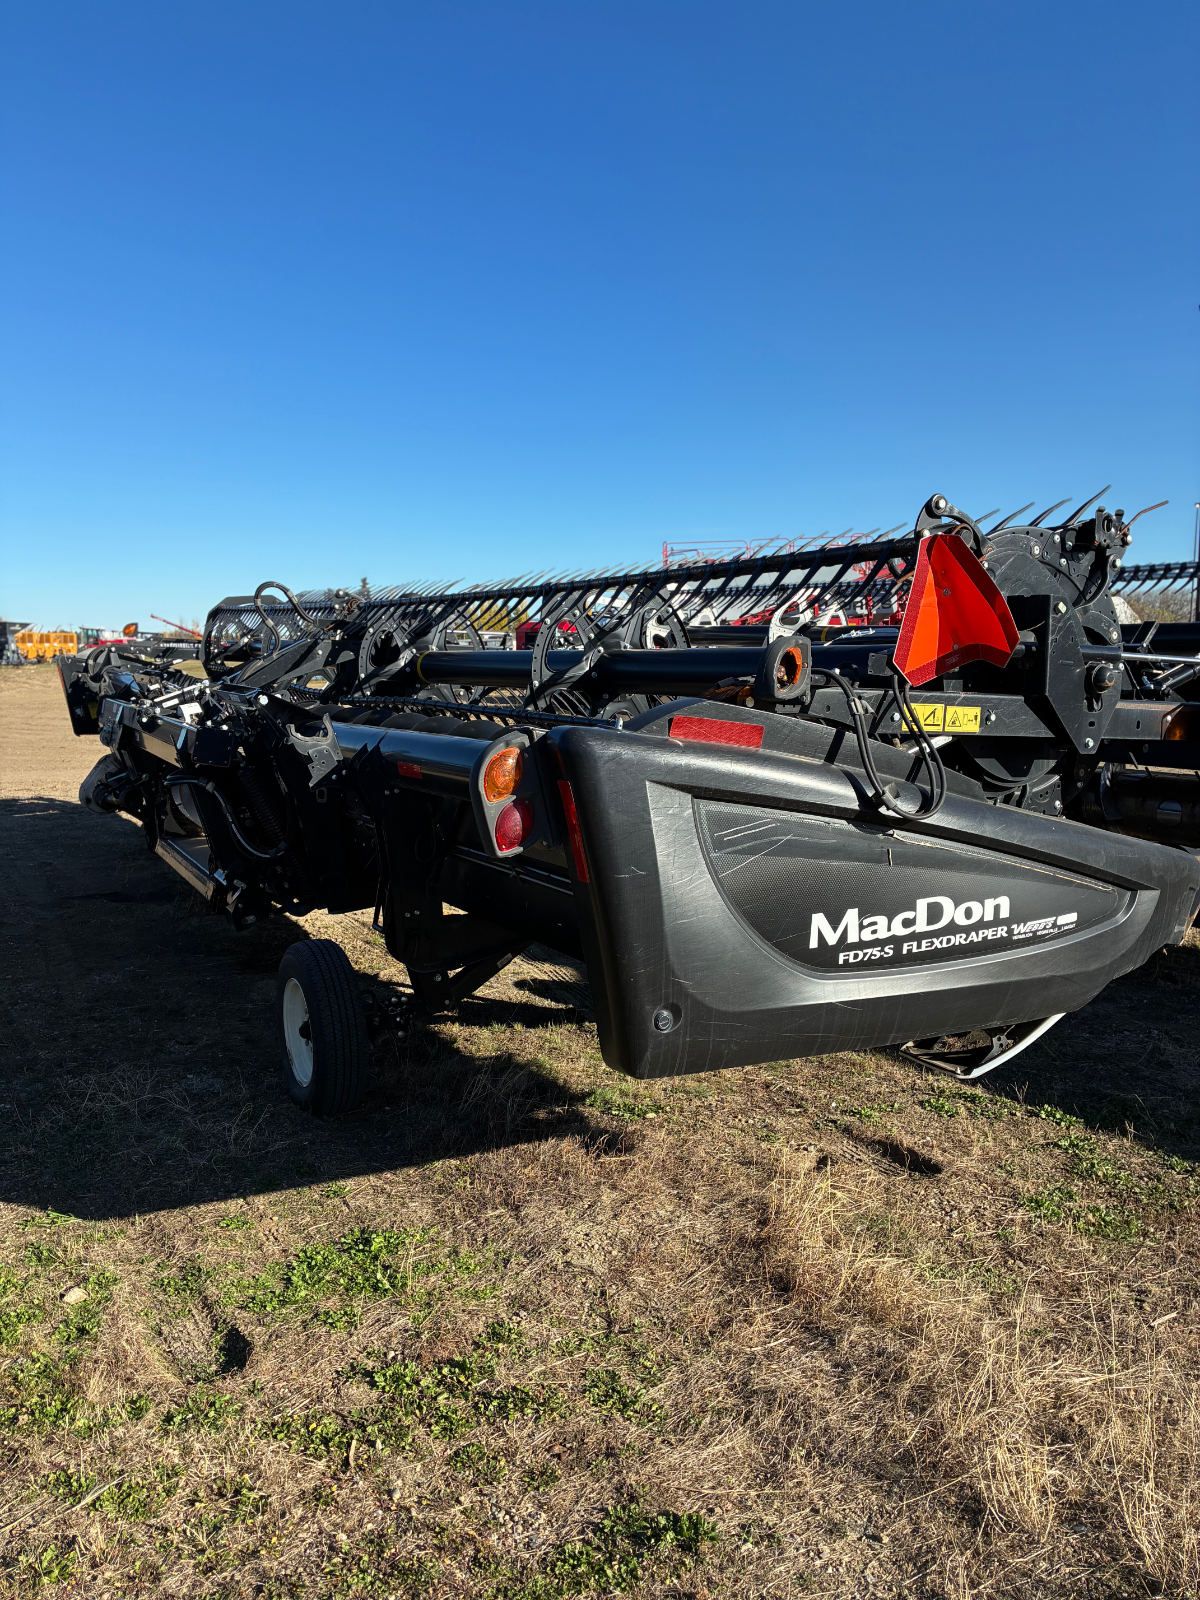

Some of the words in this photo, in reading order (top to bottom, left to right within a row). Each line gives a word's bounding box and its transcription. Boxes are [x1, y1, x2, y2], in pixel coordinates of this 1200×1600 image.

[809, 896, 1010, 949] MacDon
[839, 945, 893, 964] FD75-S
[902, 925, 1008, 954] FLEXDRAPER
